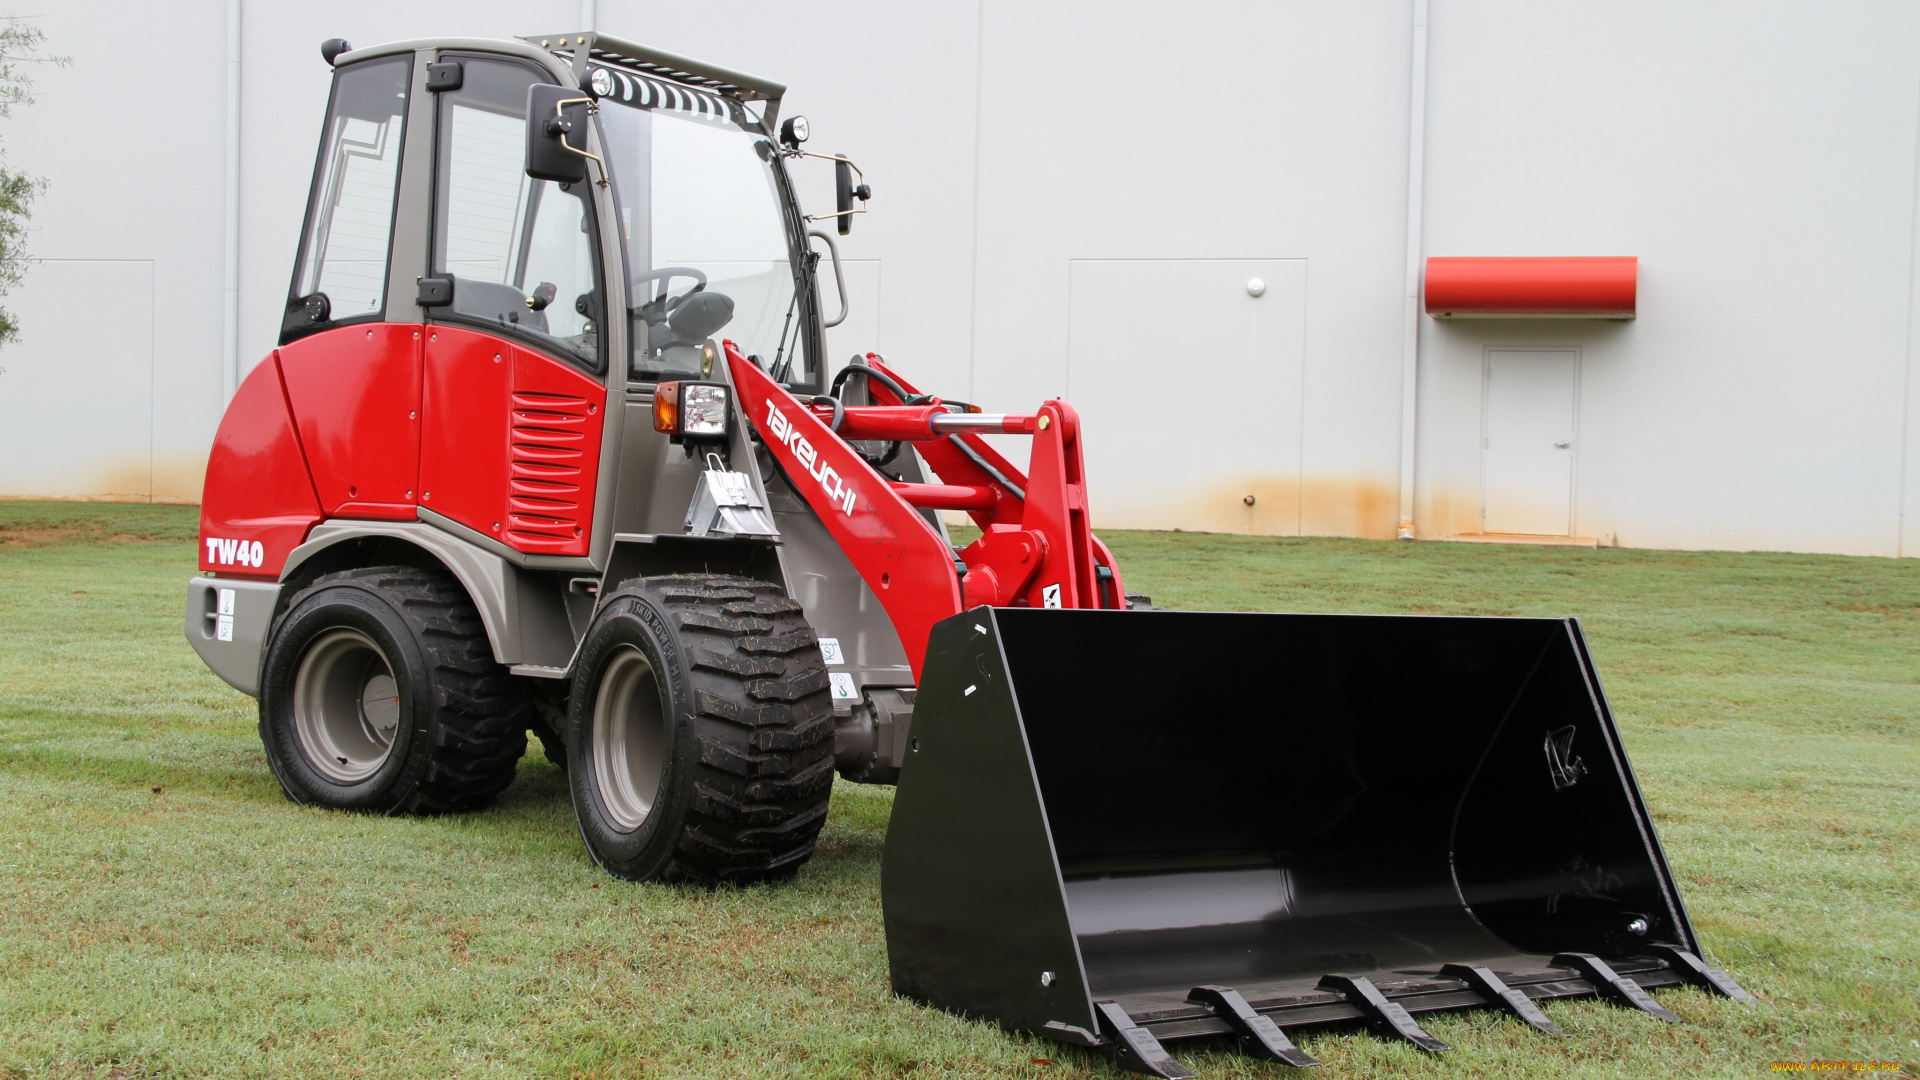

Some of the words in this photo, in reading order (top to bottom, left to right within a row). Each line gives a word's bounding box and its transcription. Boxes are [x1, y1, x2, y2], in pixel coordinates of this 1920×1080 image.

[766, 398, 857, 517] TAKEUCHI
[206, 537, 264, 568] TW40
[635, 603, 653, 622] SKID
[651, 620, 676, 660] POWER
